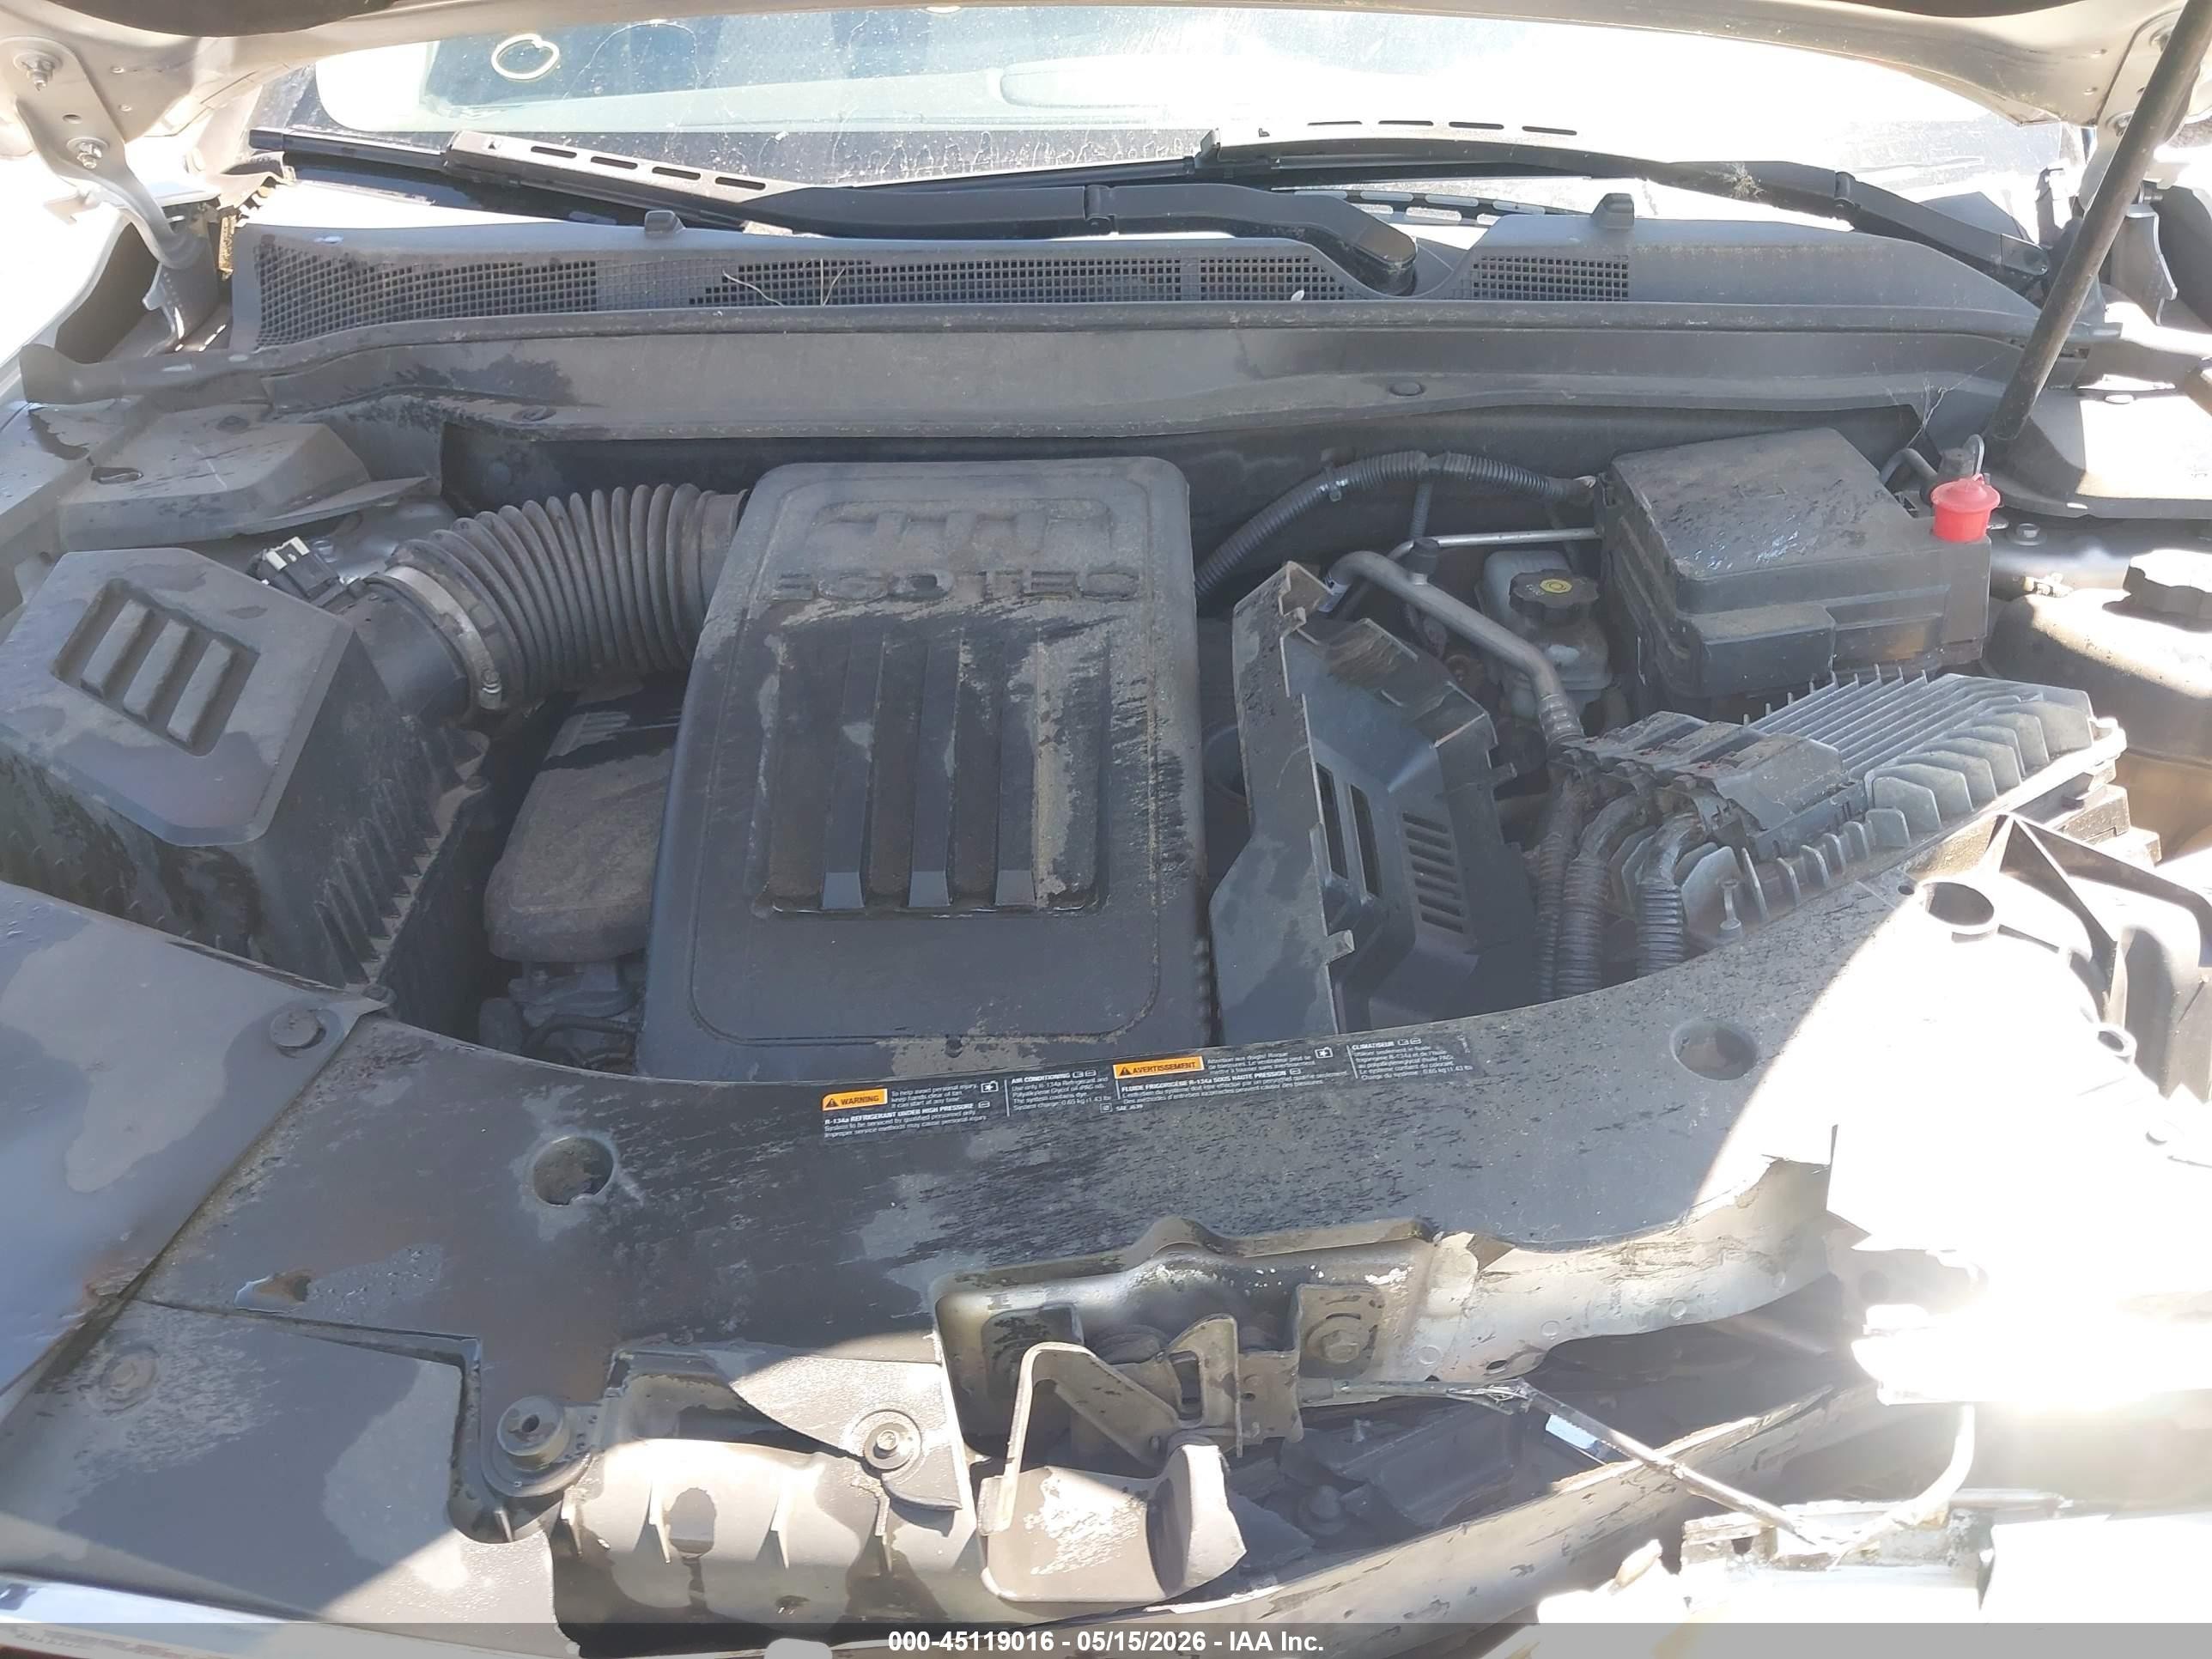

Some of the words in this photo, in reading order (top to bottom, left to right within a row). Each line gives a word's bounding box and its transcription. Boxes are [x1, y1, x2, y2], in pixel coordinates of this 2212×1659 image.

[1133, 1061, 1196, 1073] AVERTISSEMENT
[841, 1094, 880, 1107] WARNING
[850, 1112, 896, 1122] REFRIGERANT
[897, 1109, 921, 1117] UNDER
[921, 1106, 939, 1115] HIGH
[939, 1103, 975, 1113] PRESSURE
